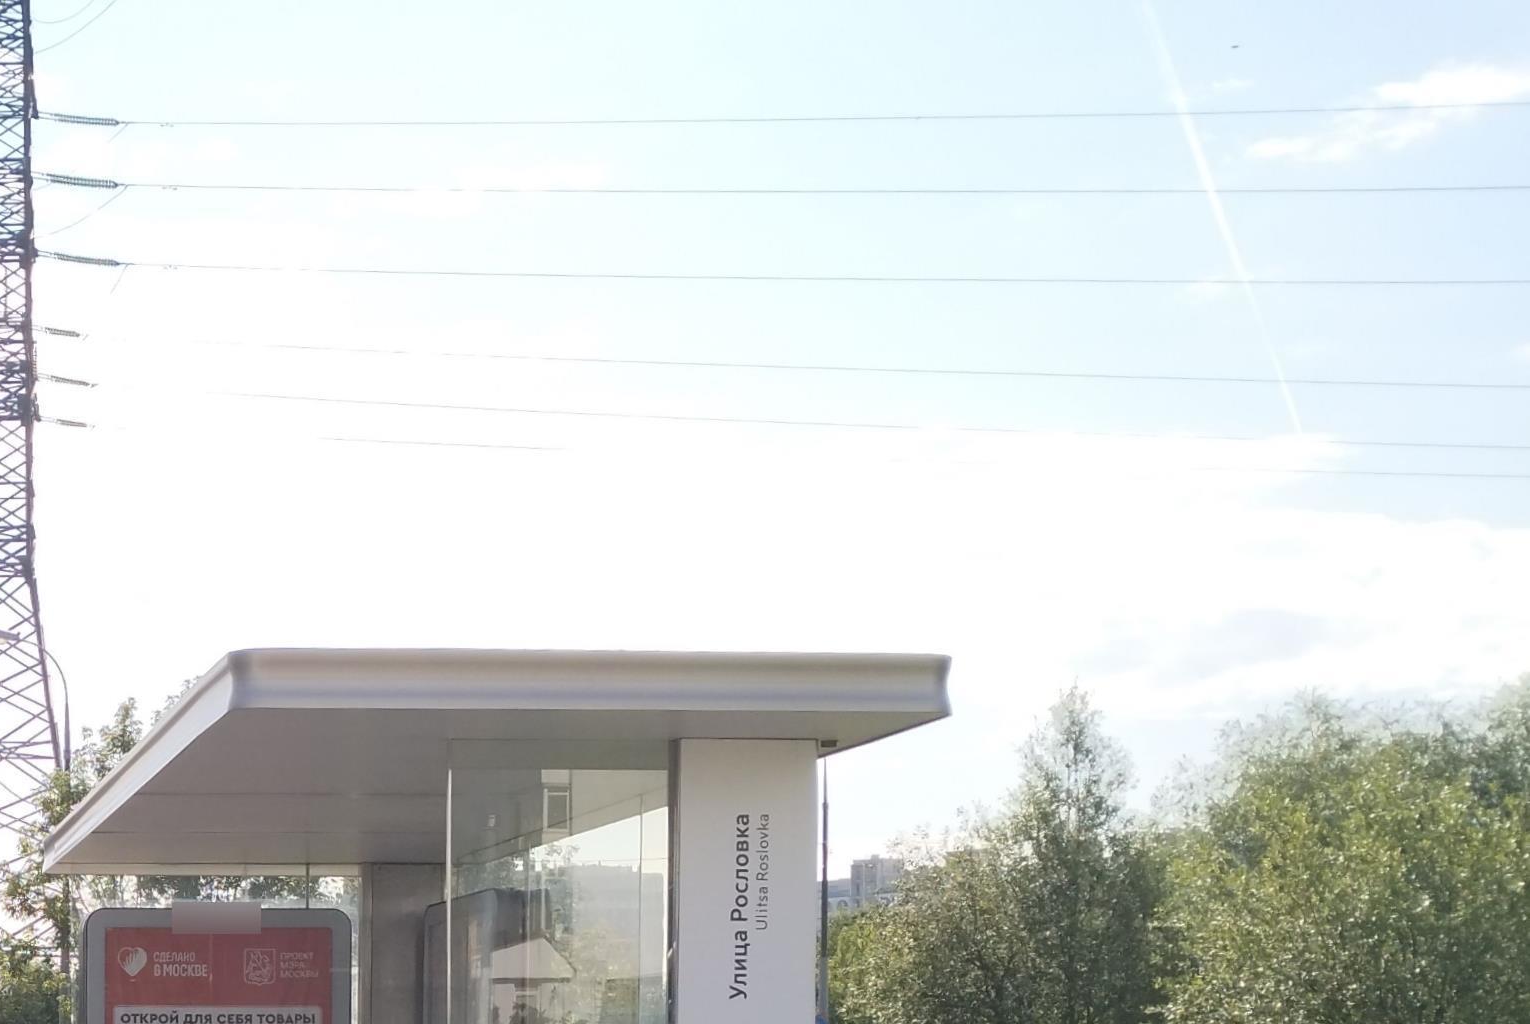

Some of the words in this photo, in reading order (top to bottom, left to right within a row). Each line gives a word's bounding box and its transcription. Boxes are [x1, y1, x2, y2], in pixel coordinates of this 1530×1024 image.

[730, 814, 750, 922] Рословка
[756, 813, 770, 882] Roslovka
[755, 886, 768, 931] Ulitsa
[153, 951, 196, 963] СДЕЛАНО
[162, 964, 208, 977] МОСКВЕ
[729, 930, 750, 999] Улица
[120, 1010, 179, 1024] ОТКРОЙ
[217, 1013, 253, 1024] СЕБЯ
[256, 1013, 316, 1024] ТОВАРЫ
